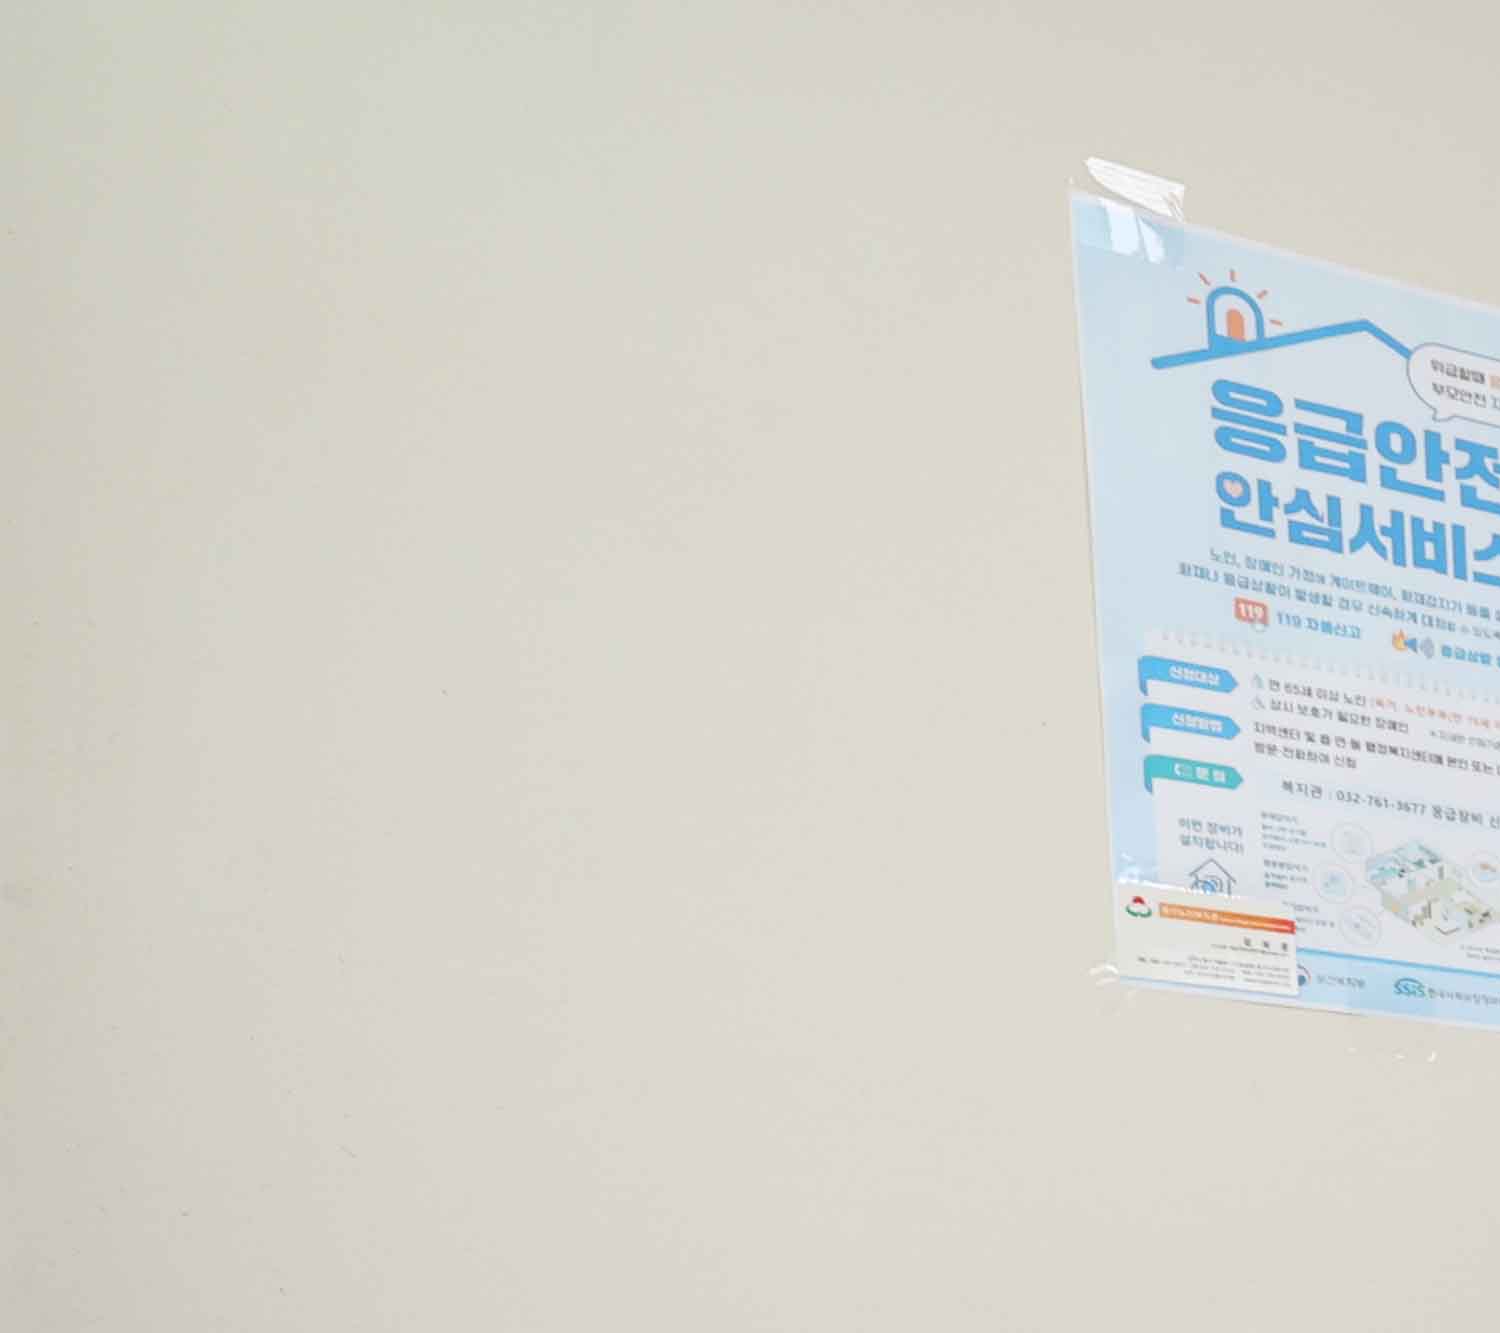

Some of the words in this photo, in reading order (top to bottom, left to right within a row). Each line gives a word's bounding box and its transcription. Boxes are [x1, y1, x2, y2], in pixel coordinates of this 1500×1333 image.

[1238, 602, 1264, 620] 119
[1277, 611, 1302, 627] 119
[1316, 688, 1339, 702] 이상
[1343, 693, 1367, 707] 노인
[1253, 721, 1301, 740] 지역센터
[1374, 718, 1409, 734] 장애인
[1281, 778, 1322, 797] 복지관
[1431, 805, 1483, 825] 응급장비
[1178, 816, 1201, 831] 이런
[1206, 821, 1243, 838] 장비가
